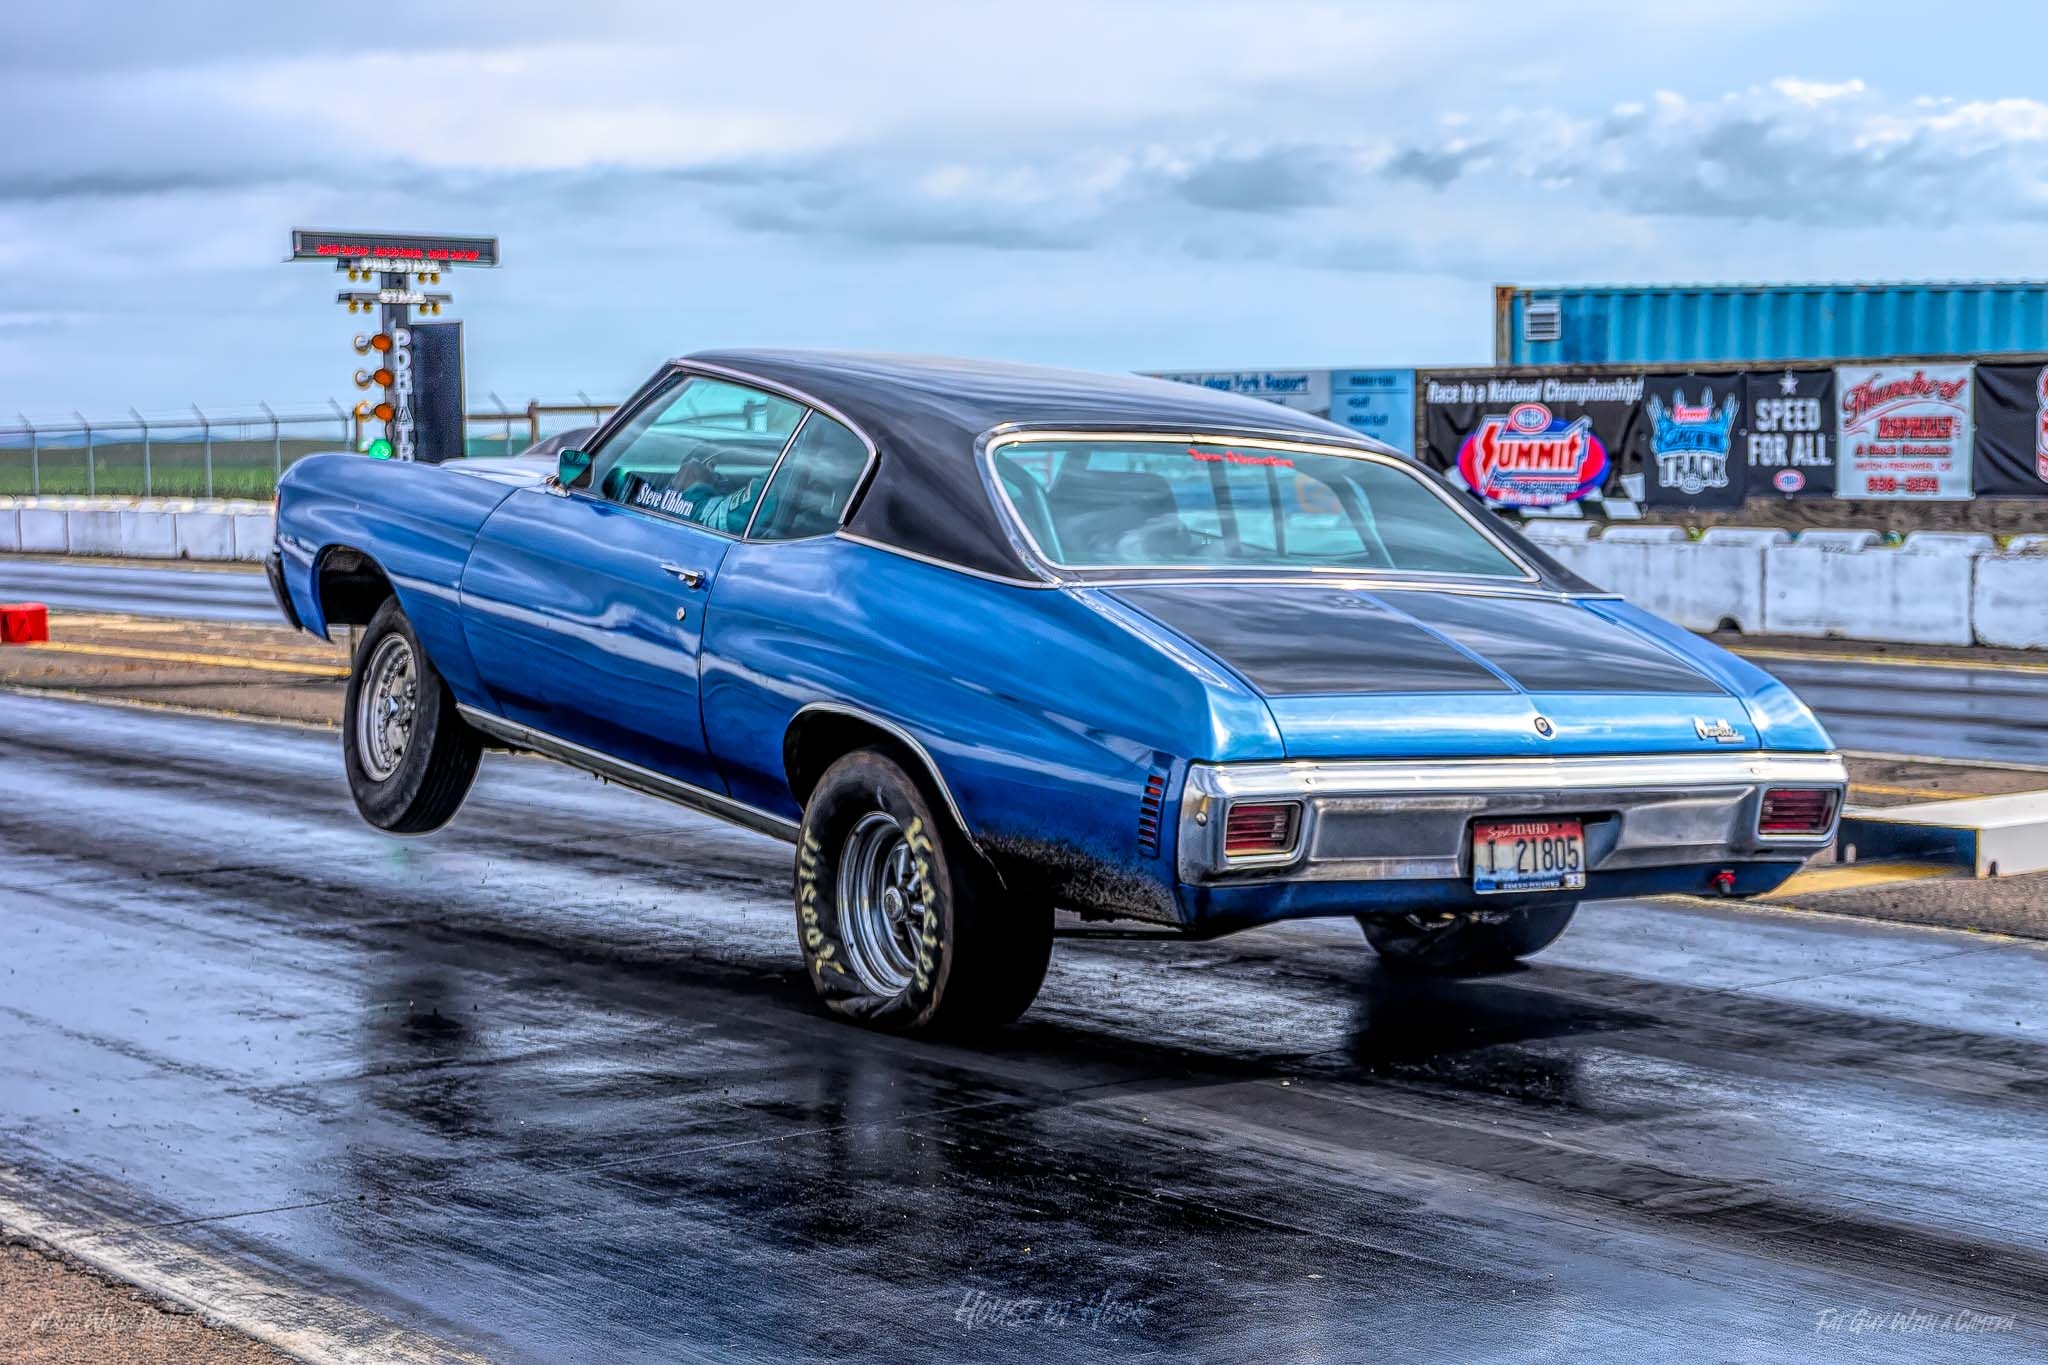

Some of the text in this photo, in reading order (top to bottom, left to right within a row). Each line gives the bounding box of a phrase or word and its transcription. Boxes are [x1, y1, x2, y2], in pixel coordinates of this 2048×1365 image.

[1428, 376, 1645, 406] Race to a National Championship!
[1755, 398, 1821, 431] SPEED
[1478, 419, 1588, 485] SUMMIT
[1748, 433, 1788, 466] FOR
[637, 482, 694, 517] Steve Uhlorn
[1511, 823, 1549, 836] IDAHO
[1516, 835, 1579, 874] 21805
